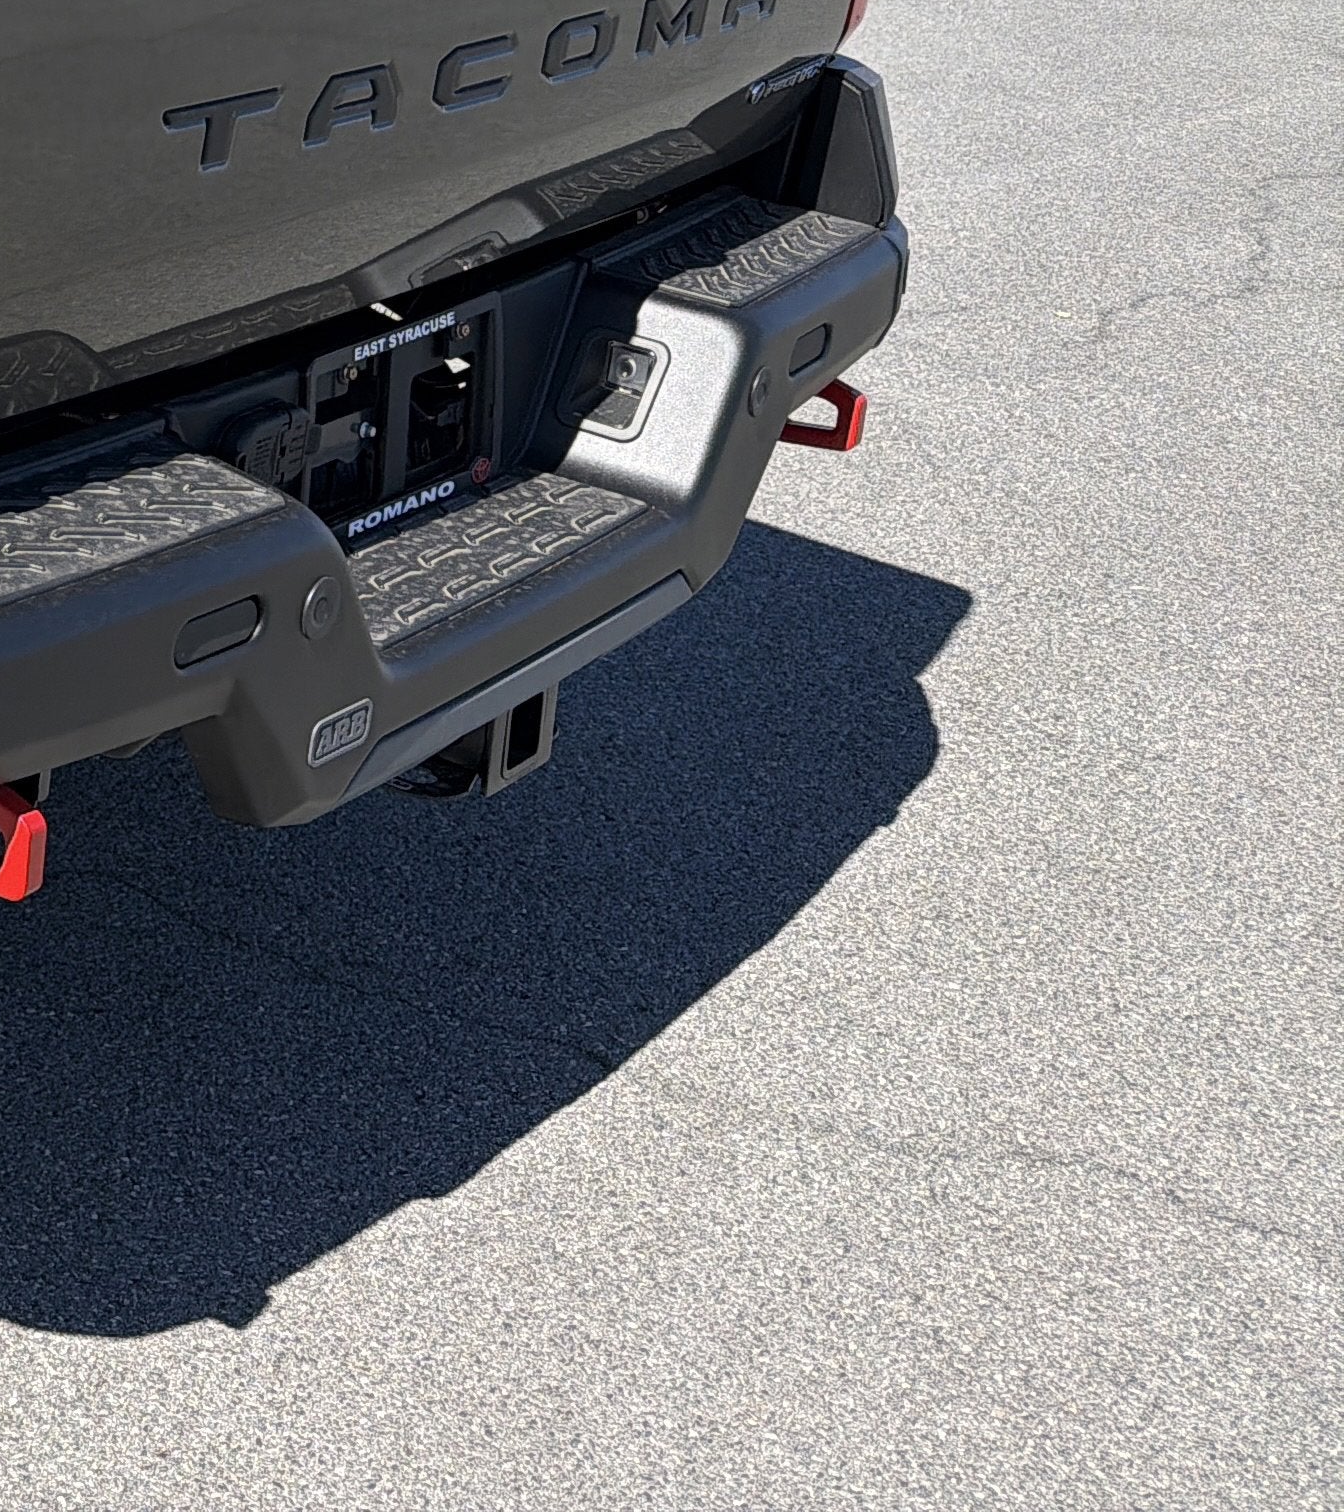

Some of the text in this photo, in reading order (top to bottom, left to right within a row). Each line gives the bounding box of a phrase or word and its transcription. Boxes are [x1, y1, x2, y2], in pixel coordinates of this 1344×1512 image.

[353, 311, 456, 362] EAST SYRACUSE
[347, 480, 456, 538] ROMANO
[315, 707, 368, 757] ARB
